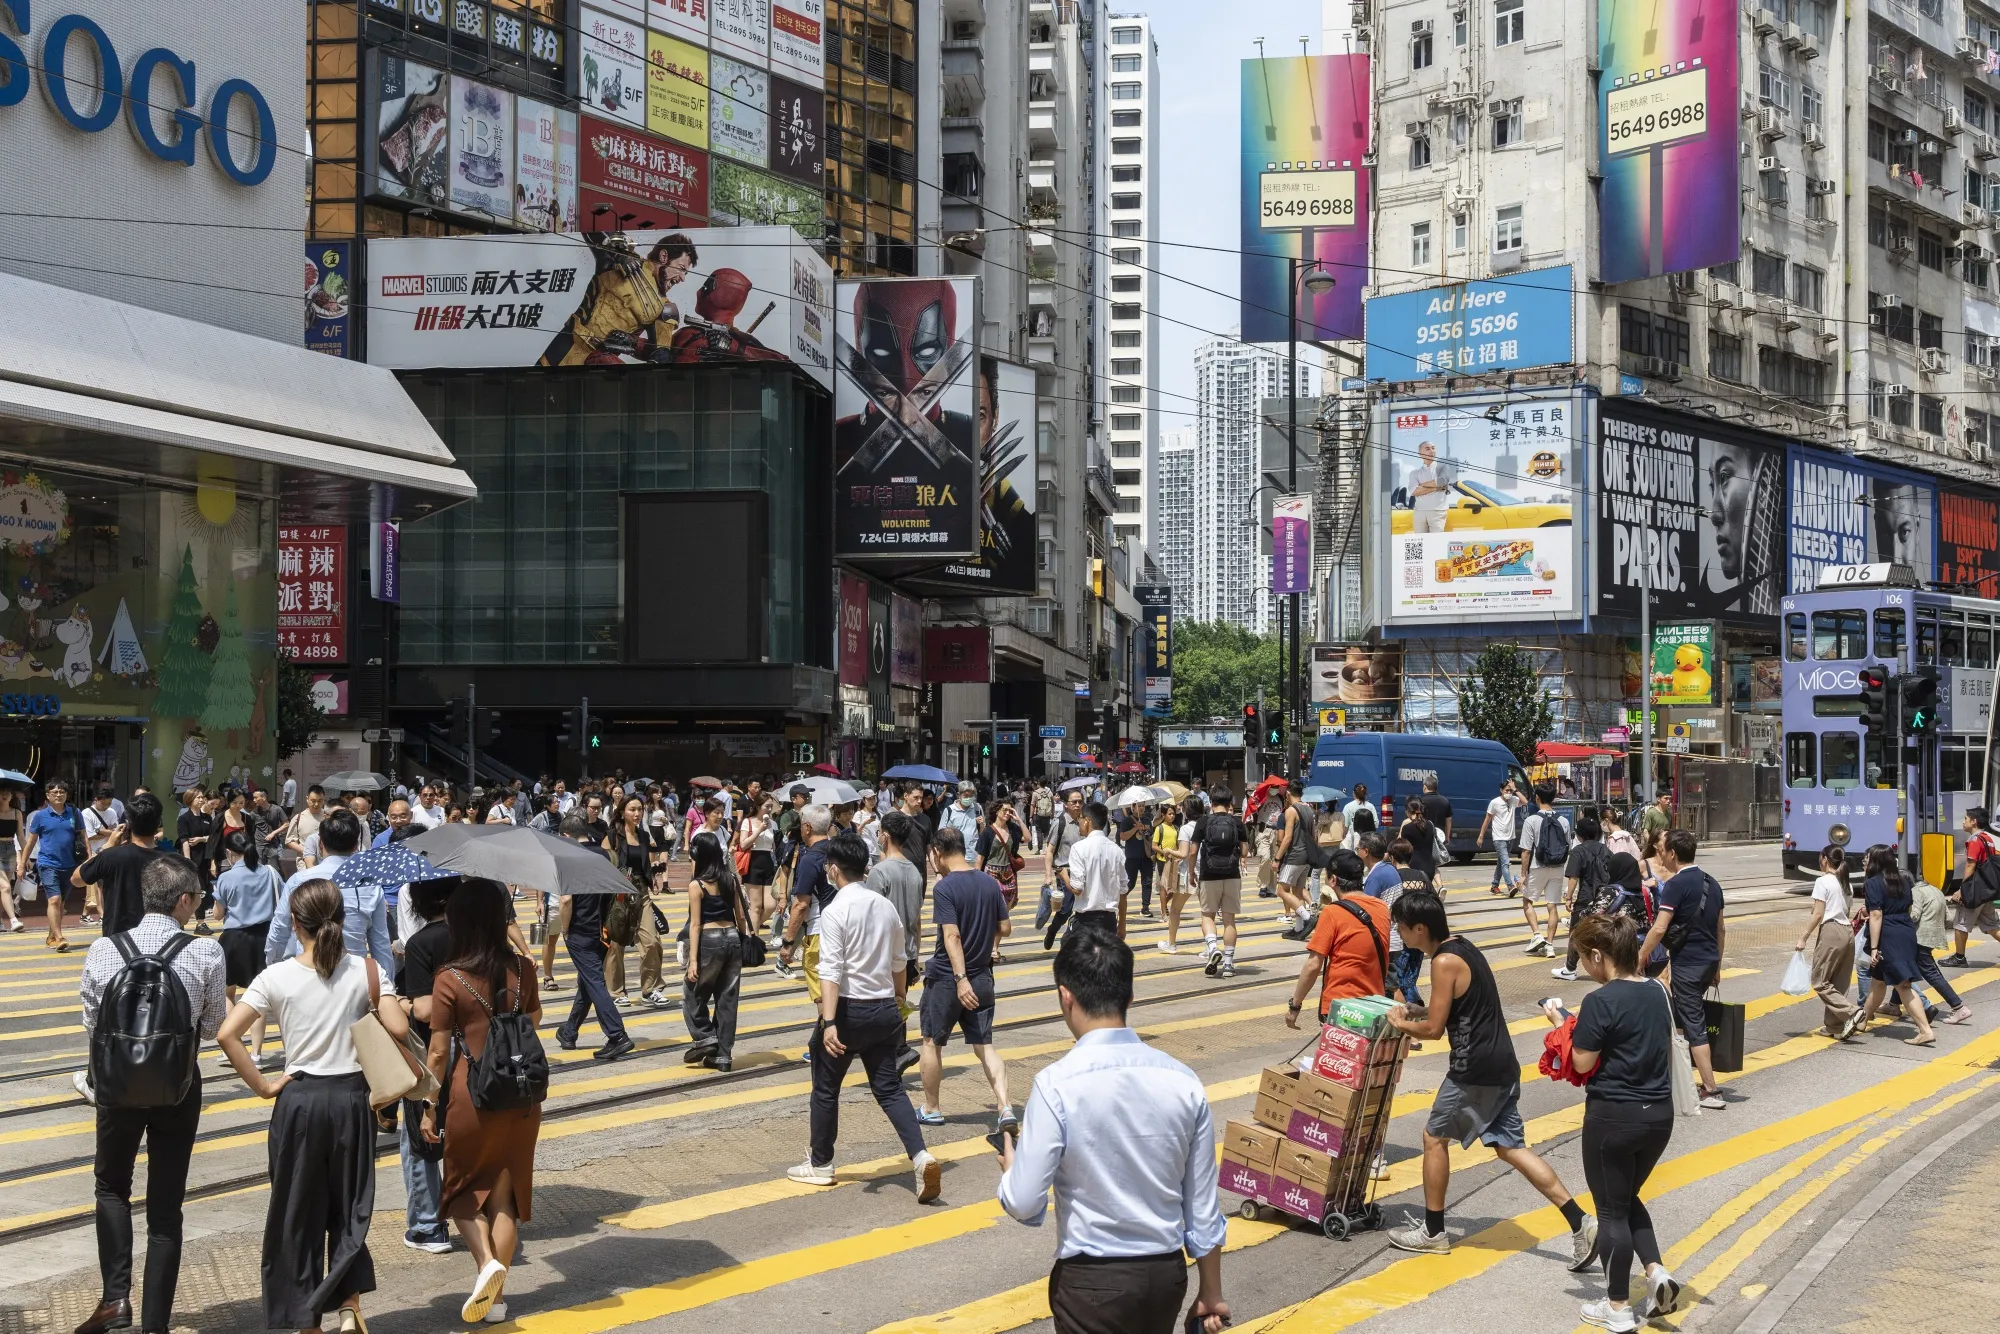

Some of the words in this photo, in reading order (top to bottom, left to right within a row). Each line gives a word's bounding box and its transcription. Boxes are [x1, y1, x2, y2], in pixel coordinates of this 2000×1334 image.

[805, 1, 820, 14] 6/F
[592, 20, 636, 49] 新巴黎
[804, 53, 820, 65] 6398
[385, 84, 397, 95] 3F
[625, 86, 643, 103] 5/F
[1650, 92, 1670, 104] TEL:
[690, 97, 706, 112] 5/F
[1610, 114, 1655, 141] 5649
[1658, 102, 1705, 130] 6988
[608, 136, 685, 178] 麻辣派對
[608, 163, 642, 184] CHILI
[644, 172, 685, 196] PARTY
[813, 162, 822, 175] 5F
[1263, 183, 1301, 193] 招租熱線
[1303, 183, 1321, 192] TEL:
[1262, 200, 1307, 217] 5649
[1310, 198, 1353, 215] 6988
[384, 276, 424, 295] MARVEL
[426, 276, 468, 294] STUDIOS
[470, 268, 578, 296] 兩大支嘢
[1426, 295, 1455, 315] Ad
[1460, 290, 1507, 310] Here
[322, 325, 343, 338] 6/F
[1416, 320, 1464, 344] 9556
[1469, 312, 1519, 337] 5696
[1416, 339, 1519, 374] 廣告位招租
[1512, 407, 1564, 424] 馬百良
[1602, 417, 1657, 445] THERE'S
[1661, 430, 1695, 453] ONLY
[1602, 437, 1630, 493] ONE
[1632, 444, 1695, 504] SOUVENIR
[1792, 459, 1864, 538] AMBITION
[1602, 491, 1608, 519] I
[1611, 493, 1654, 526] WANT
[1656, 501, 1696, 532] FROM
[1940, 491, 1998, 552] WINNING
[309, 529, 330, 539] 4/F
[881, 519, 931, 529] WOLVERINE
[859, 532, 900, 544] 7.24(三)
[901, 532, 949, 544] 爽爆大銀幕
[1791, 527, 1838, 561] NEEDS
[1842, 536, 1865, 565] NO
[278, 546, 335, 577] 麻辣
[1613, 522, 1687, 593] PARIS.
[1956, 546, 1983, 566] ISN'T
[1836, 565, 1871, 582] 106
[278, 580, 335, 612] 派對
[1783, 600, 1795, 610] 106
[1886, 594, 1903, 605] 106
[303, 646, 338, 658] 4898
[1156, 615, 1167, 669] IKEA
[1799, 667, 1863, 691] MÍOG
[1803, 804, 1881, 816] 醫學輕齡專家
[1337, 1005, 1365, 1022] Sprite
[1325, 1027, 1361, 1049] Coca-Cola
[1318, 1053, 1355, 1075] Coca-Cola
[1303, 1121, 1329, 1144] vita
[1233, 1170, 1257, 1190] vita
[1284, 1188, 1309, 1210] vita
